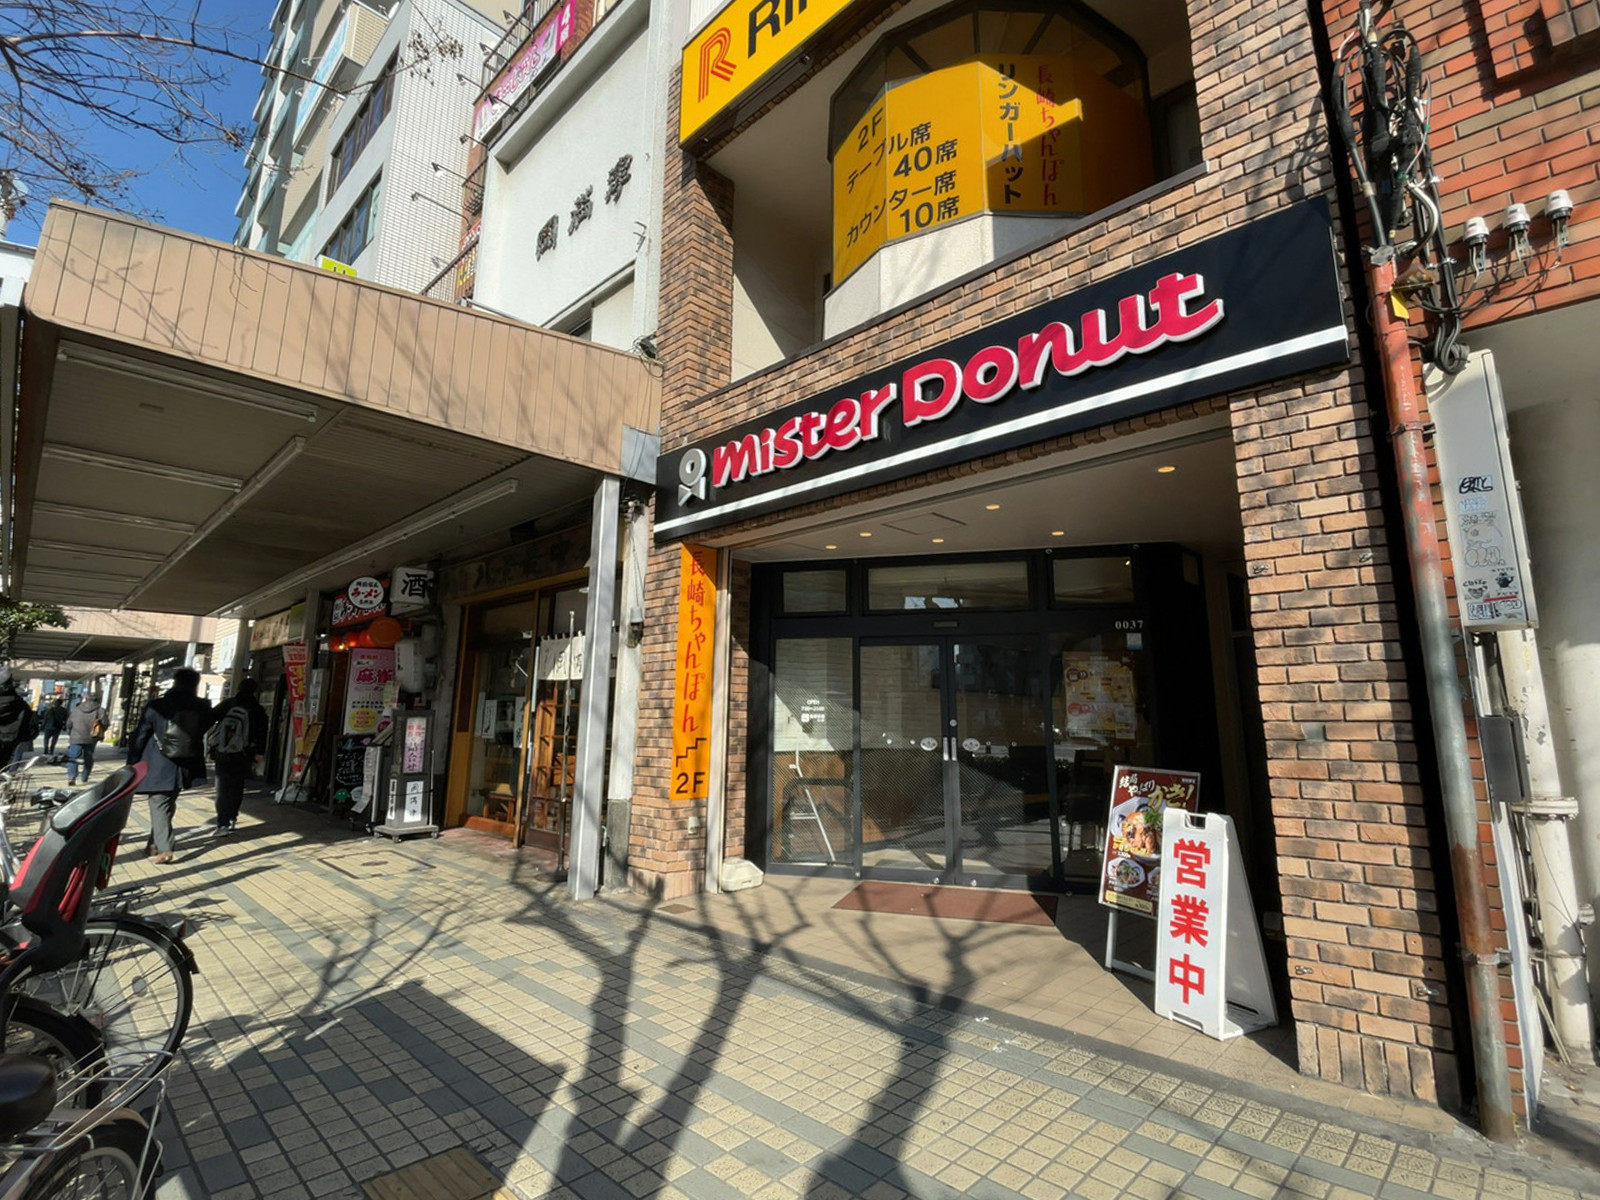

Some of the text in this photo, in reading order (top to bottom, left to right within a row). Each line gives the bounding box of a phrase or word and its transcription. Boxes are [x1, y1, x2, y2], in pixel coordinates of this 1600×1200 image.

[857, 108, 884, 149] 2F
[998, 63, 1023, 204] リンガーハット
[1036, 64, 1064, 206] 長崎ちゃんぽん
[847, 121, 931, 193] テーブル席
[894, 138, 957, 178] 40席
[847, 170, 956, 247] カウンター席
[900, 196, 959, 233] 10席
[903, 272, 1223, 428] Donut
[351, 588, 382, 599] ラーメン
[401, 572, 428, 598] 酒
[682, 551, 705, 733] 長崎ちゃんぽん
[1115, 620, 1143, 630] 0037
[675, 772, 705, 794] 2F
[1168, 837, 1211, 1006] 営業中
